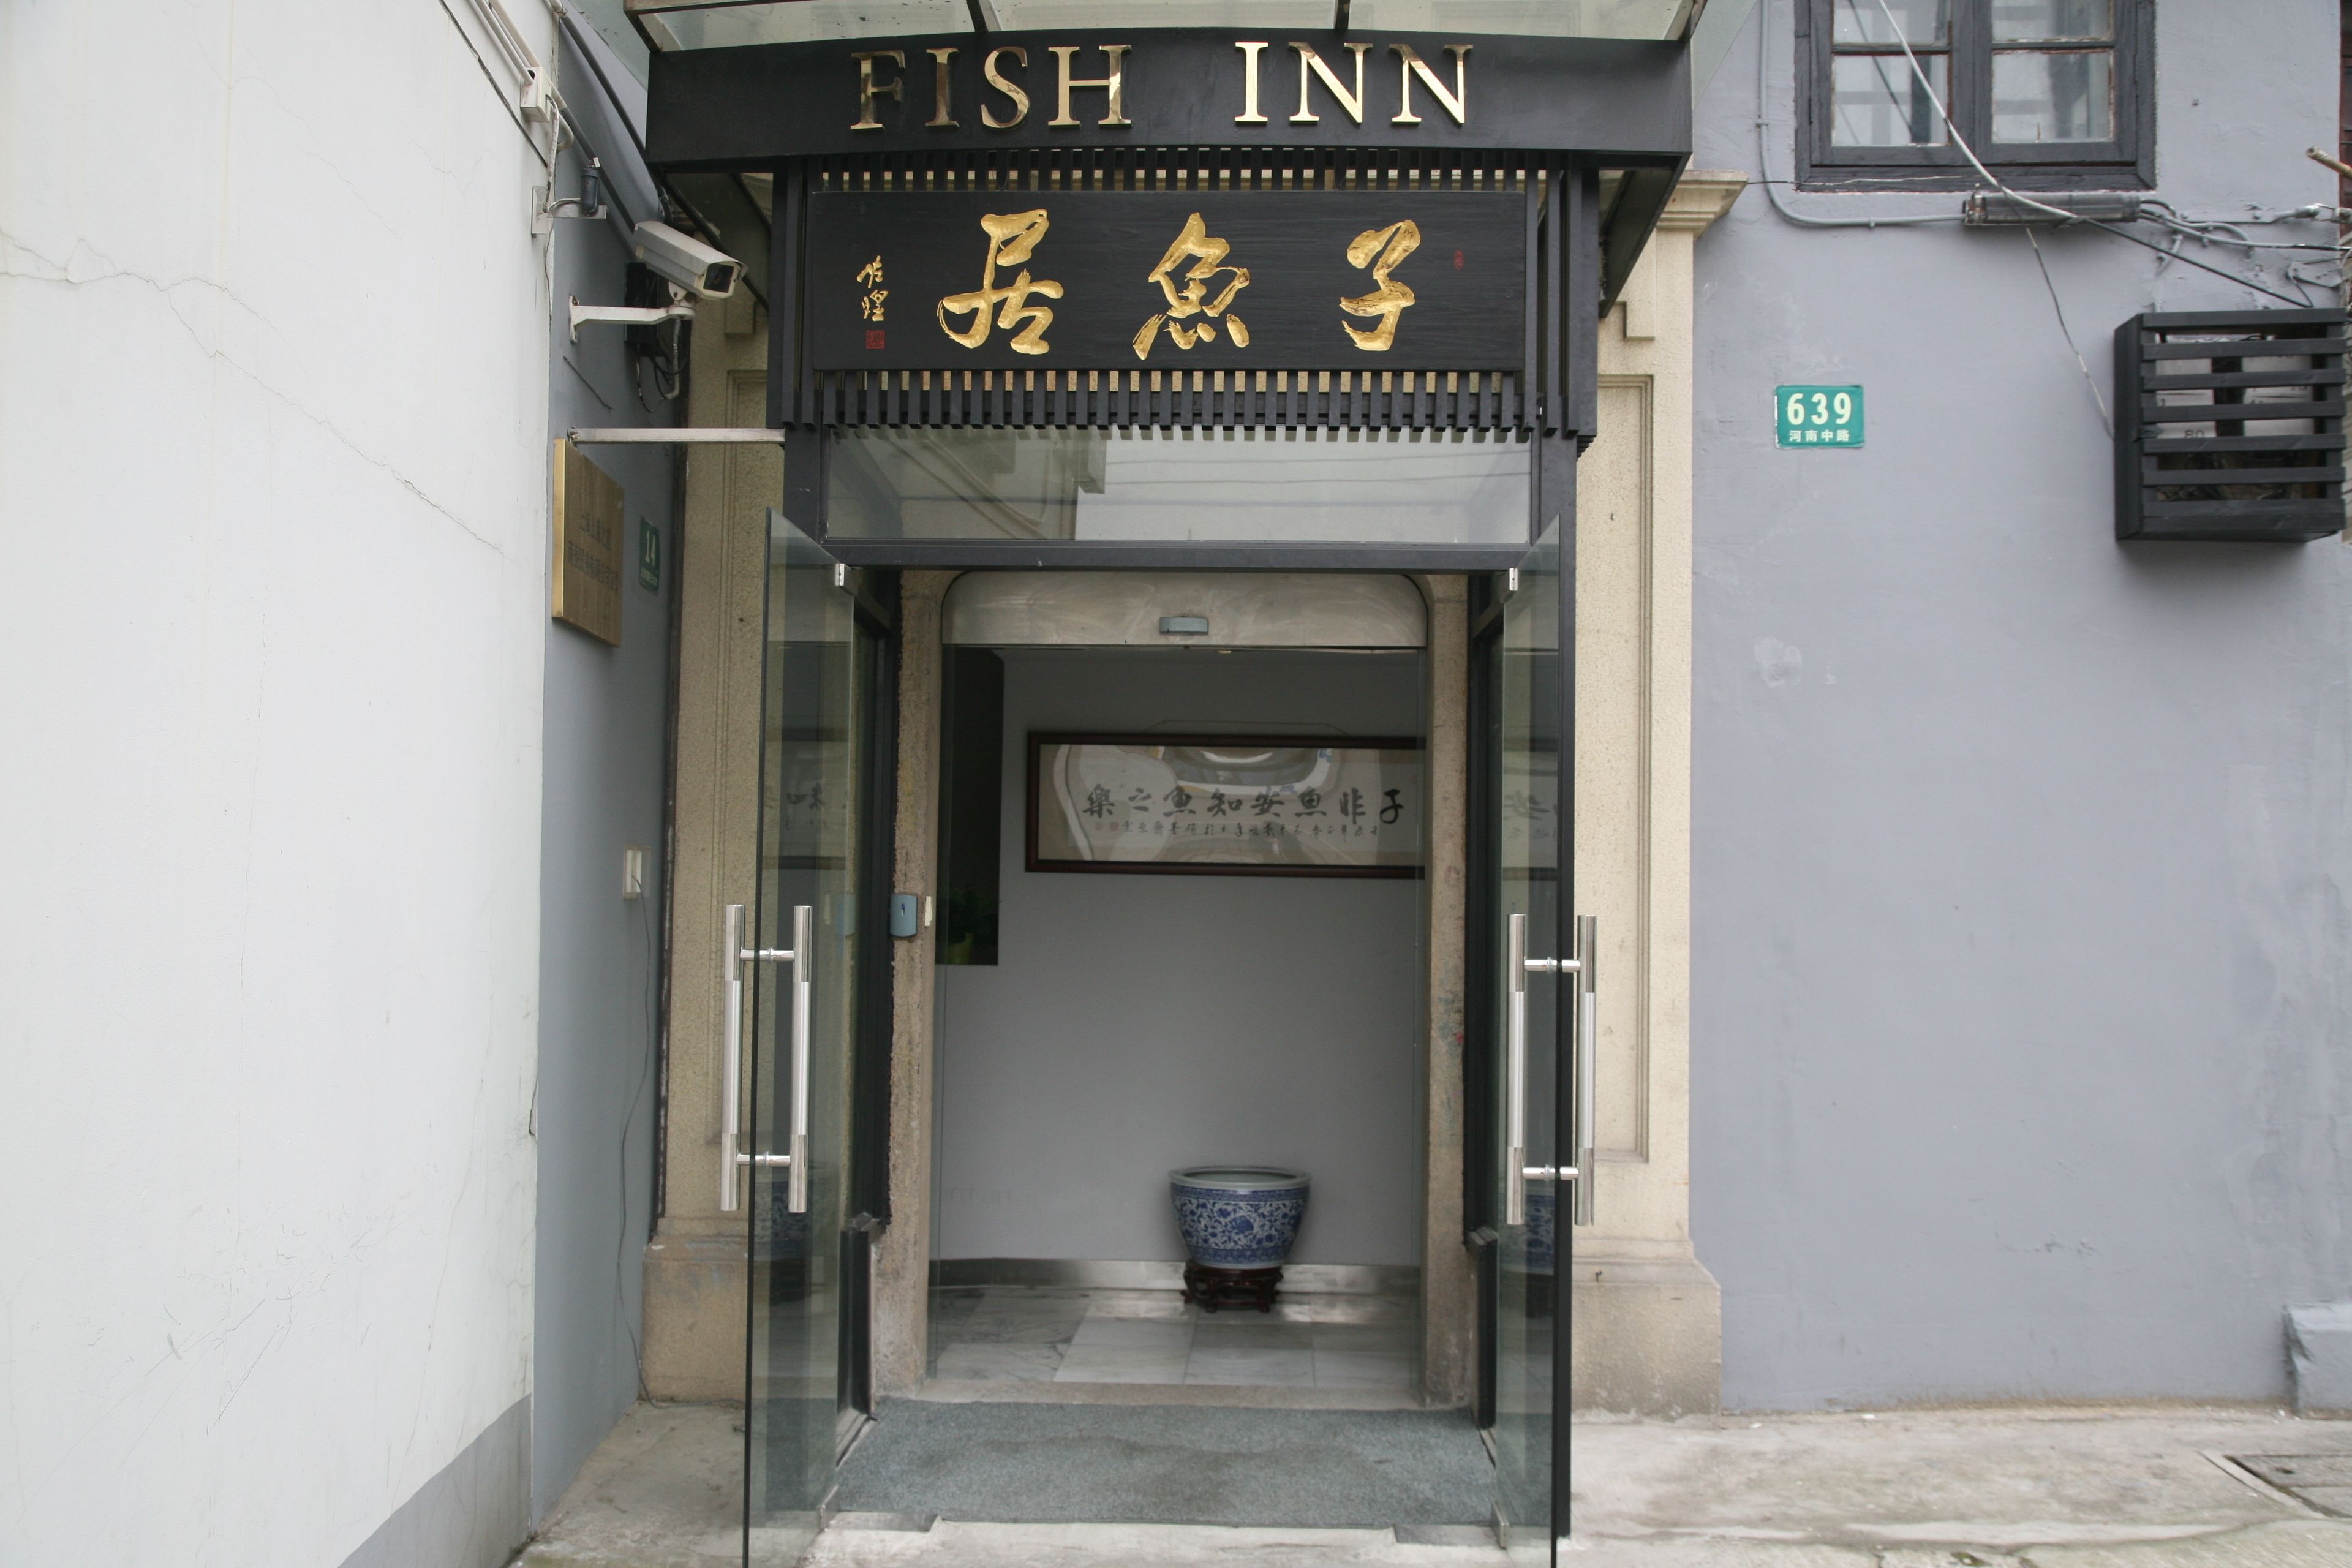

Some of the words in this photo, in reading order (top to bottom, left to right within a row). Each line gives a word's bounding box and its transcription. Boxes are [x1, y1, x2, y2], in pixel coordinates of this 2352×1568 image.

[851, 45, 1133, 130] FISH
[1234, 42, 1474, 126] INN
[1787, 392, 1852, 426] 639
[1789, 429, 1850, 442] 河南中路
[645, 530, 656, 567] 14
